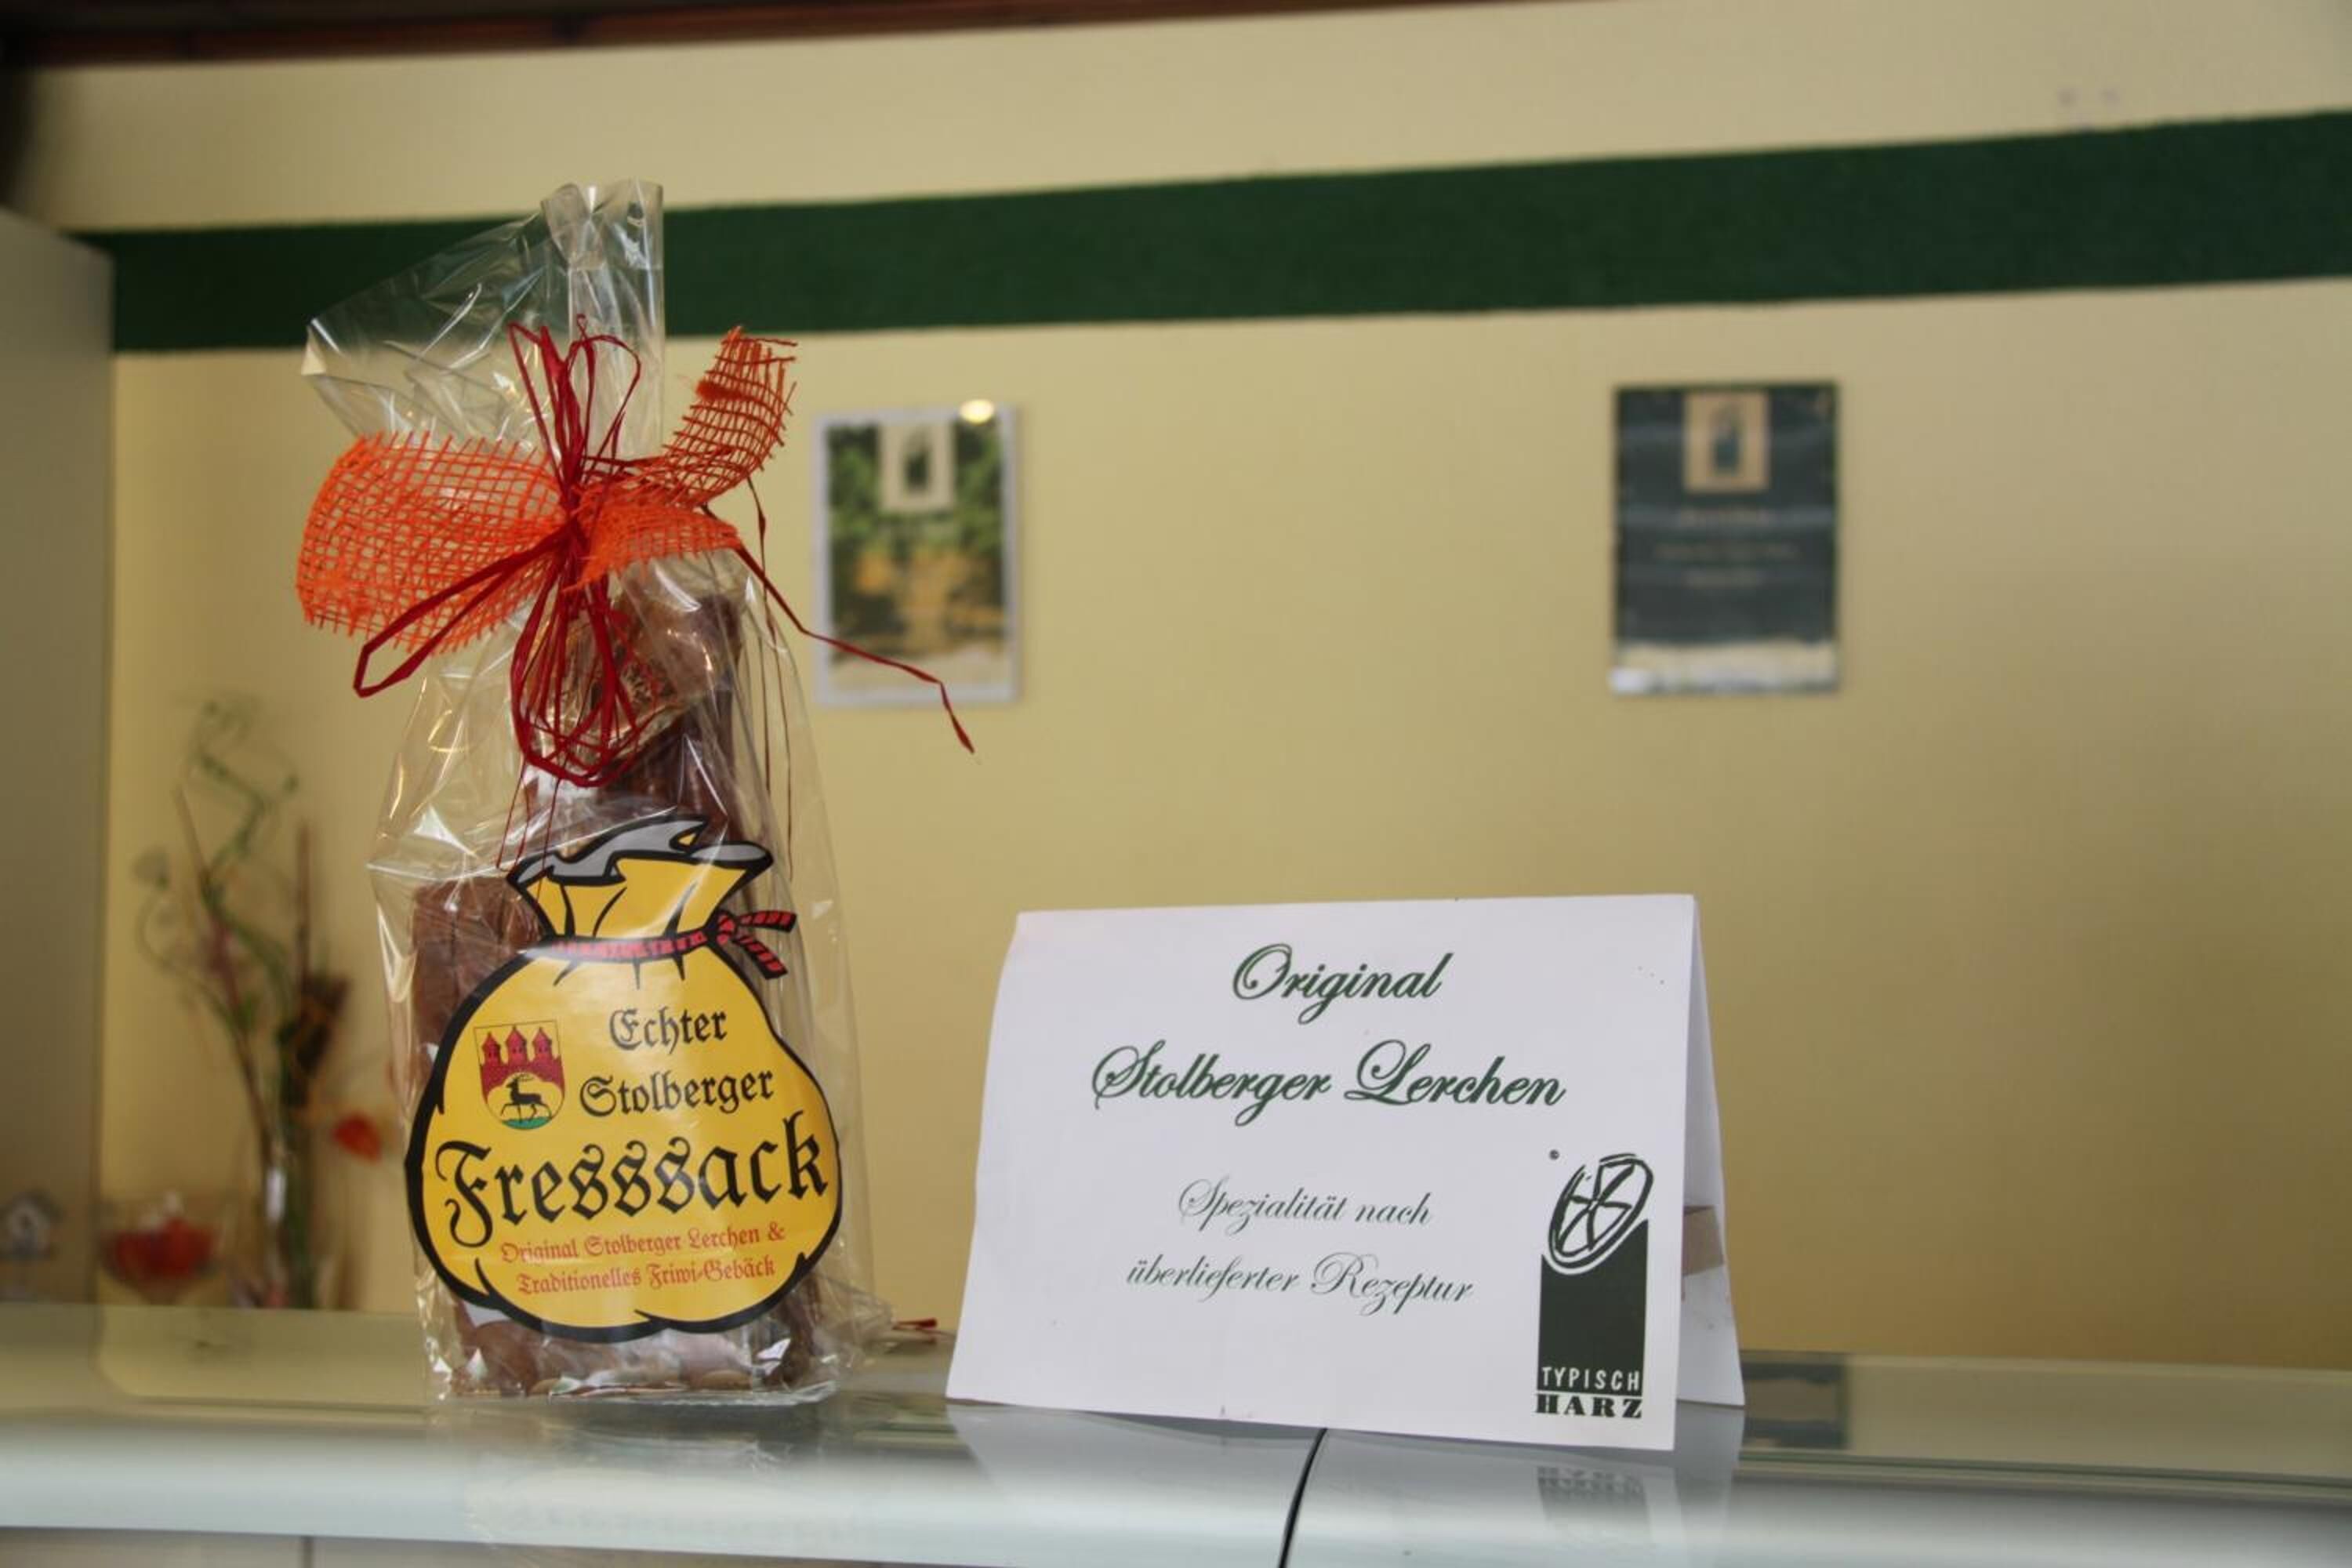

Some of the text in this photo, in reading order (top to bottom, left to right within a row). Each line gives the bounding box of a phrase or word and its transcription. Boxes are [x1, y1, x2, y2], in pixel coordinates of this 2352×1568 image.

[1232, 943, 1454, 1025] Original
[609, 1006, 727, 1054] Echter
[580, 1069, 774, 1116] Stolberger
[1092, 1040, 1566, 1127] Stolberger Lerchen
[436, 1110, 828, 1247] Fresssack
[1178, 1174, 1432, 1236] Spezialität nach
[502, 1221, 785, 1263] Original Stolberger Lerchen &
[518, 1268, 641, 1294] Traditionelles
[1127, 1253, 1473, 1316] überlieferter Rezeptur
[1541, 1367, 1639, 1391] TYPISCH
[1535, 1393, 1642, 1419] HARZ
